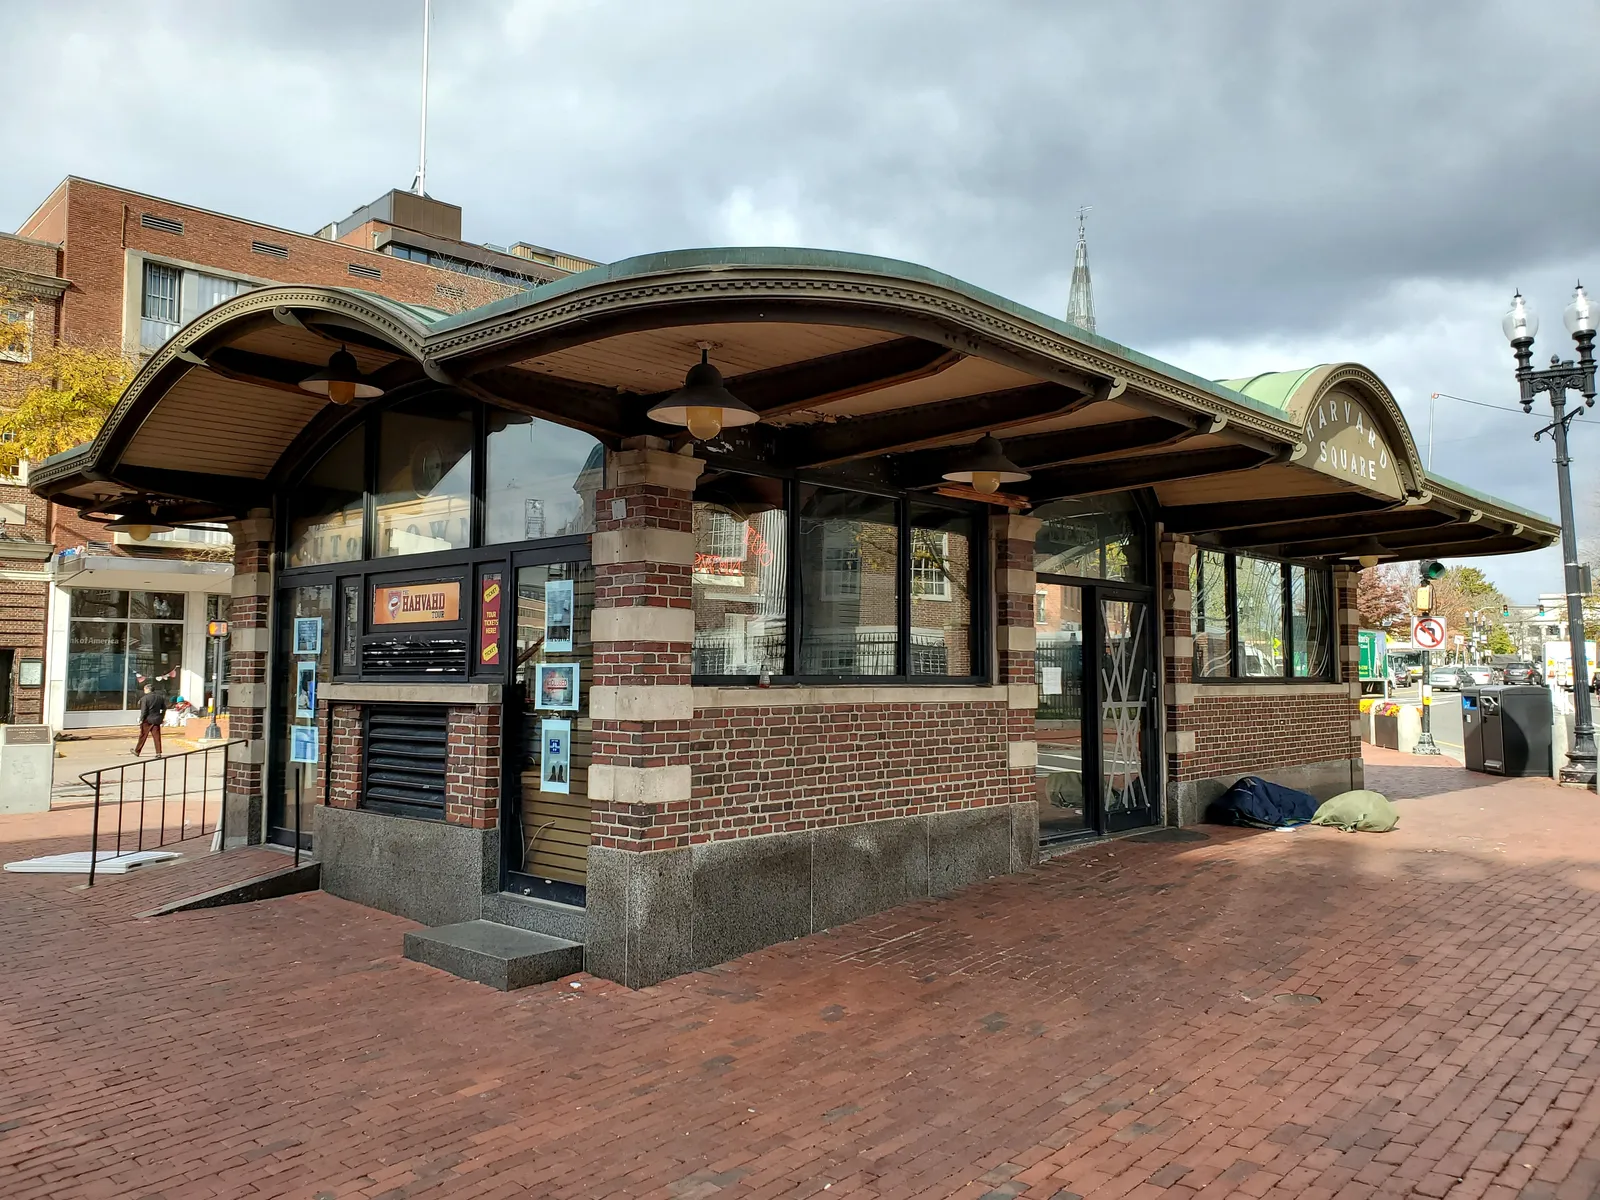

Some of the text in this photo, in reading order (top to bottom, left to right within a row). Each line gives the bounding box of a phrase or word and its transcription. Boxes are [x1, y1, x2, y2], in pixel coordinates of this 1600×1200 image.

[1306, 400, 1387, 469] HARVARD
[1320, 440, 1377, 481] SQUARE
[485, 586, 498, 599] TICKET
[402, 593, 445, 612] HAHVAHD
[432, 611, 445, 619] TOUR
[79, 636, 88, 644] of
[88, 637, 119, 645] America
[484, 646, 496, 656] TICKET
